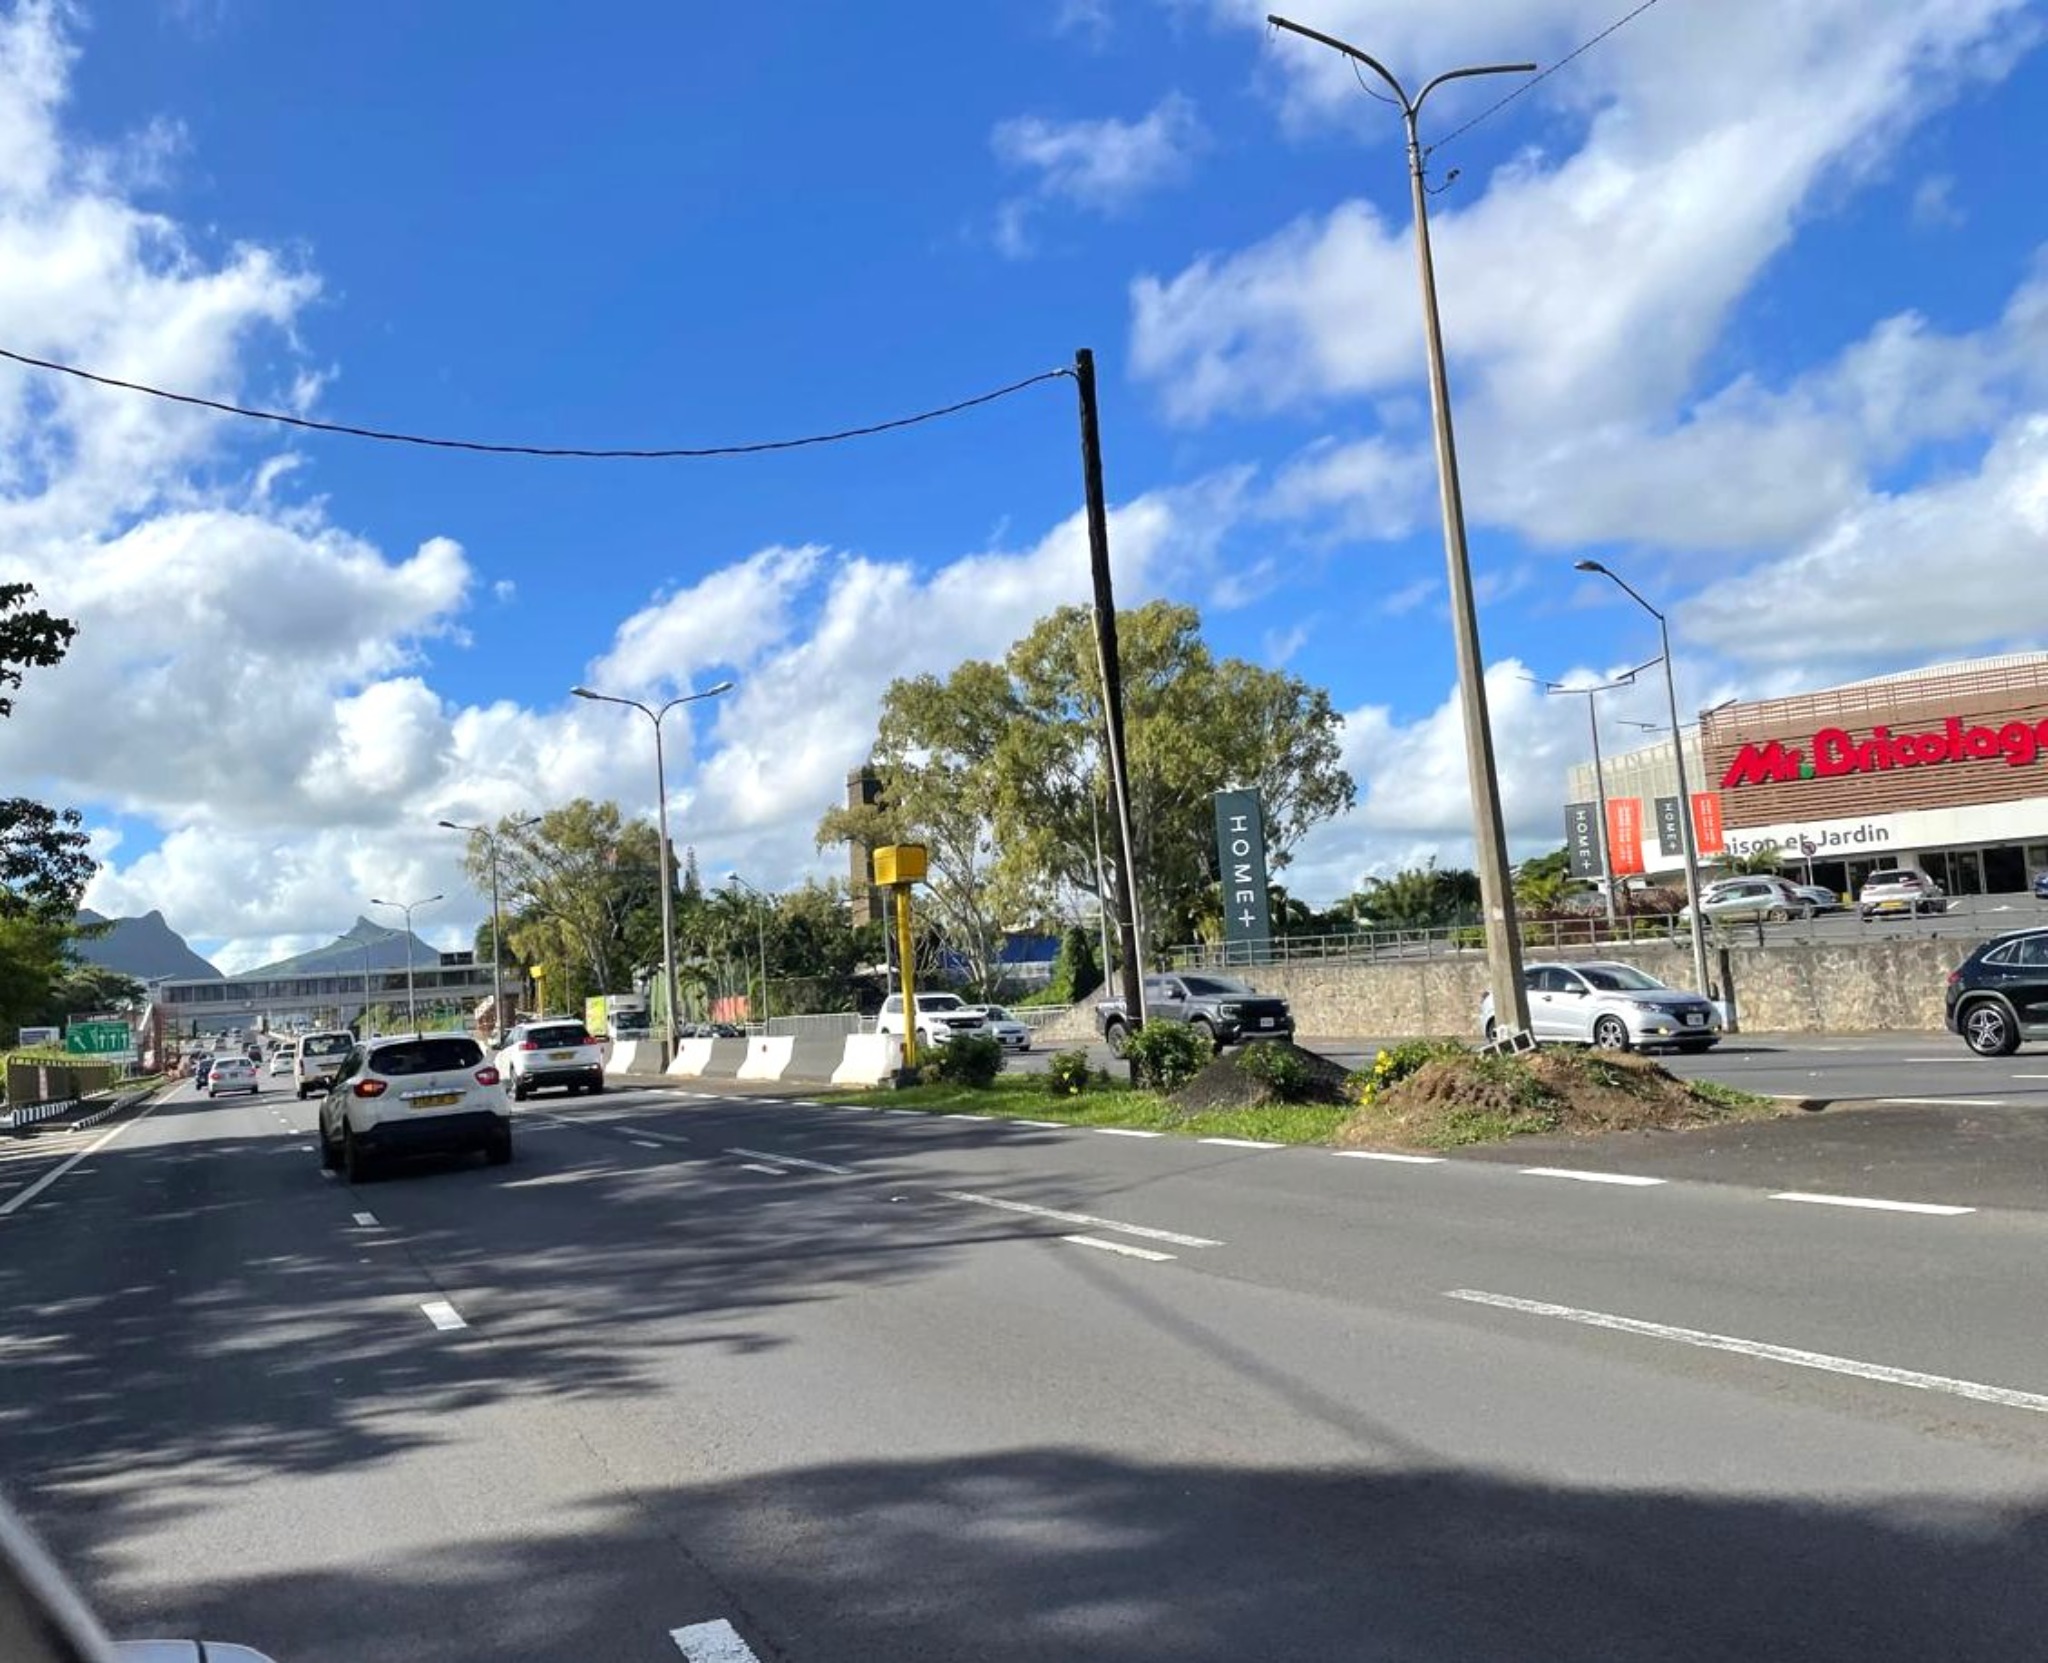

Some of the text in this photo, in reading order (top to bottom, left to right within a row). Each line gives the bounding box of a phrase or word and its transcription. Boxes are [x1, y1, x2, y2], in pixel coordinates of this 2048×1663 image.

[1721, 738, 1814, 789] Mr.
[1576, 809, 1592, 870] HOME+
[1664, 802, 1678, 851] HOME+
[1723, 836, 1778, 855] aison
[1817, 824, 1890, 848] Jardin
[1229, 815, 1256, 928] HOME+
